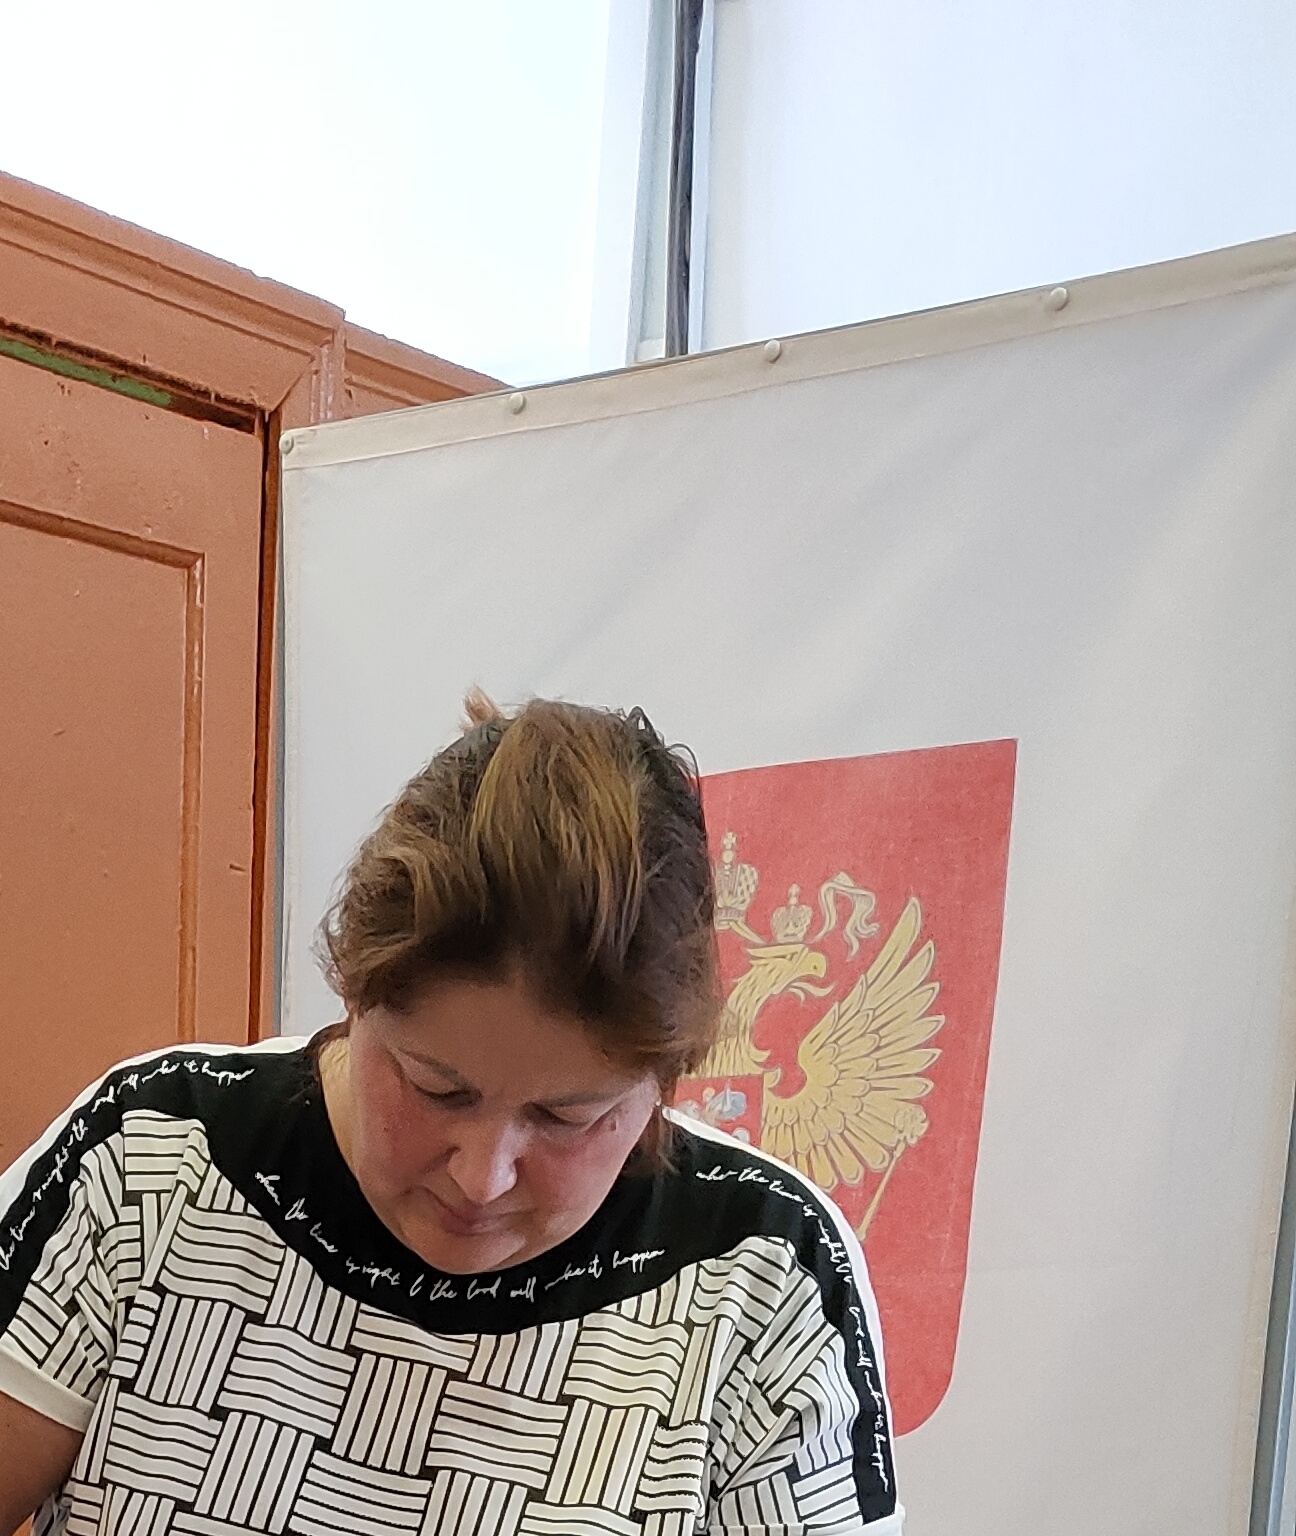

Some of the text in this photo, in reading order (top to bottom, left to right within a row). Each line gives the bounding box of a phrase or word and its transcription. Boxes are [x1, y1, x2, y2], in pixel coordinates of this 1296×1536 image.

[284, 1198, 310, 1221] the
[309, 1222, 339, 1253] time
[361, 1261, 401, 1289] right
[429, 1279, 458, 1301] the
[509, 1276, 537, 1303] will
[586, 1253, 604, 1279] it
[612, 1249, 666, 1274] happen
